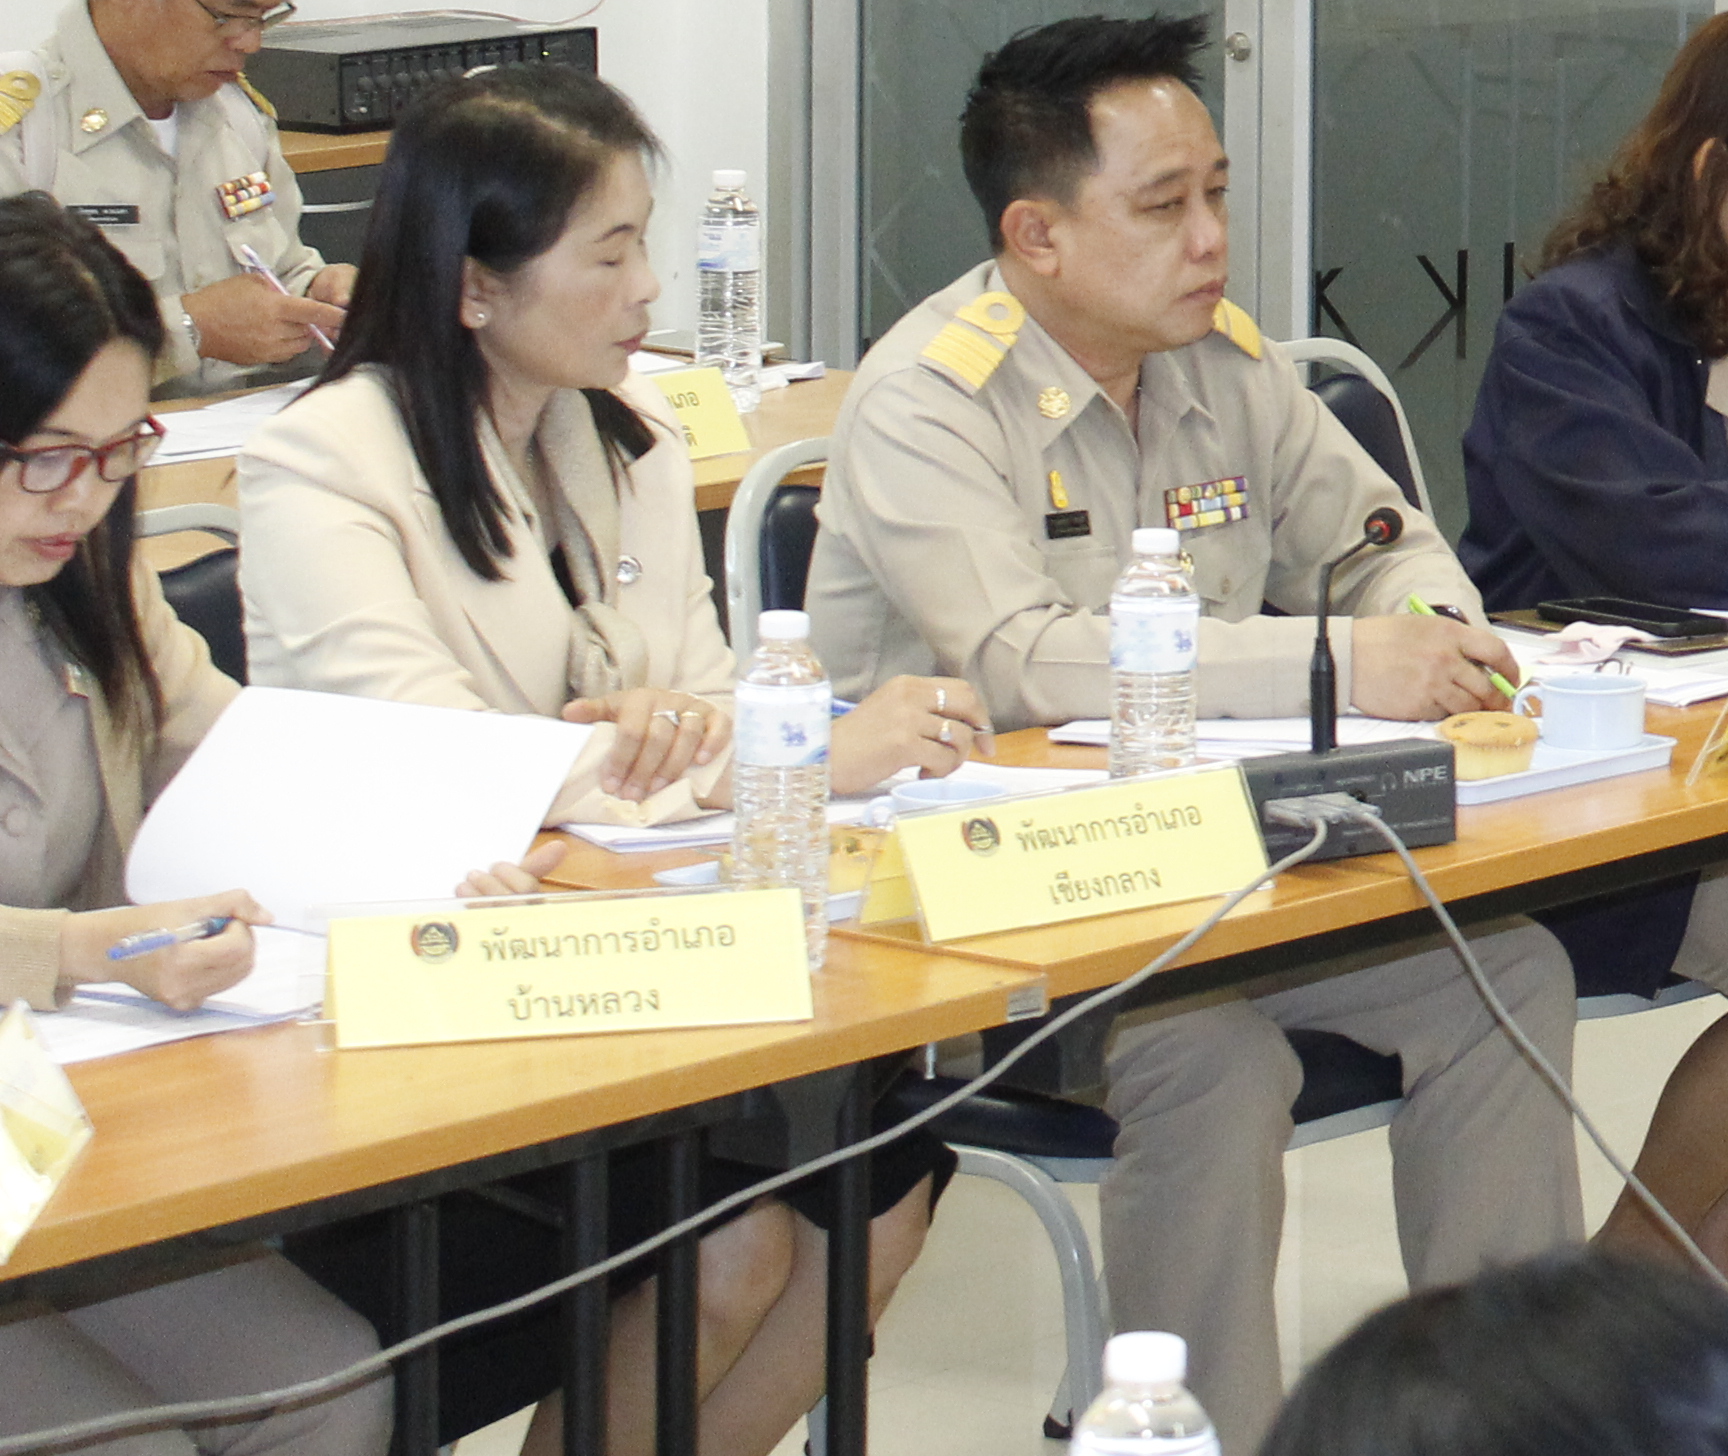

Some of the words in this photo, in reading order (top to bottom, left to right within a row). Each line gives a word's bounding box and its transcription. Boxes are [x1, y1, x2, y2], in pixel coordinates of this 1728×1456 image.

[1403, 765, 1448, 784] NPE
[1015, 803, 1203, 853] พัฒนาการอำเภอ
[1049, 866, 1162, 906] เชียงกลาง
[479, 917, 737, 962] พัฒนาการอำเภอ
[507, 984, 661, 1022] บ้านหลวง
